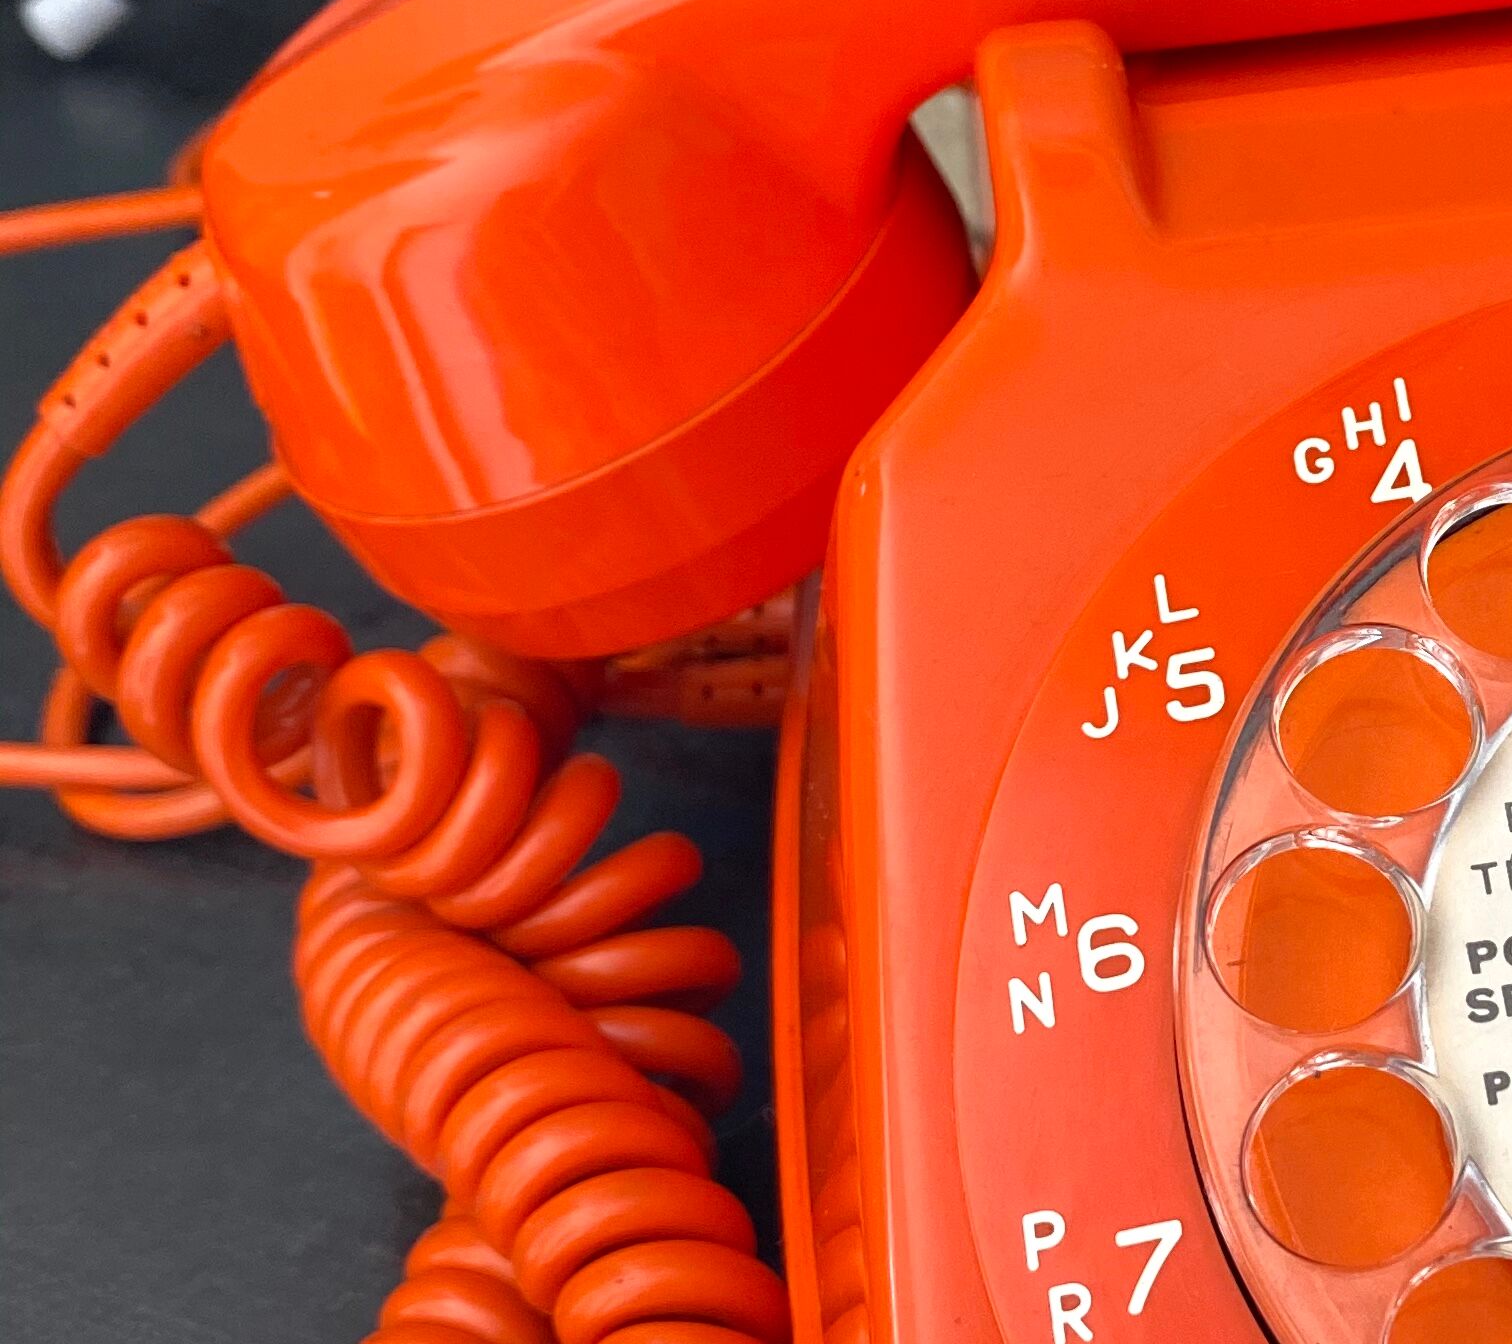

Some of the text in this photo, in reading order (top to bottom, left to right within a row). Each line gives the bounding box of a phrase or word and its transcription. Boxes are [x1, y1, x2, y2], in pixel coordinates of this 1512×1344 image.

[1293, 377, 1412, 484] GHI
[1371, 439, 1432, 504] 4
[1165, 647, 1225, 722] 5
[1077, 913, 1145, 993] 6
[1115, 1219, 1183, 1316] 7
